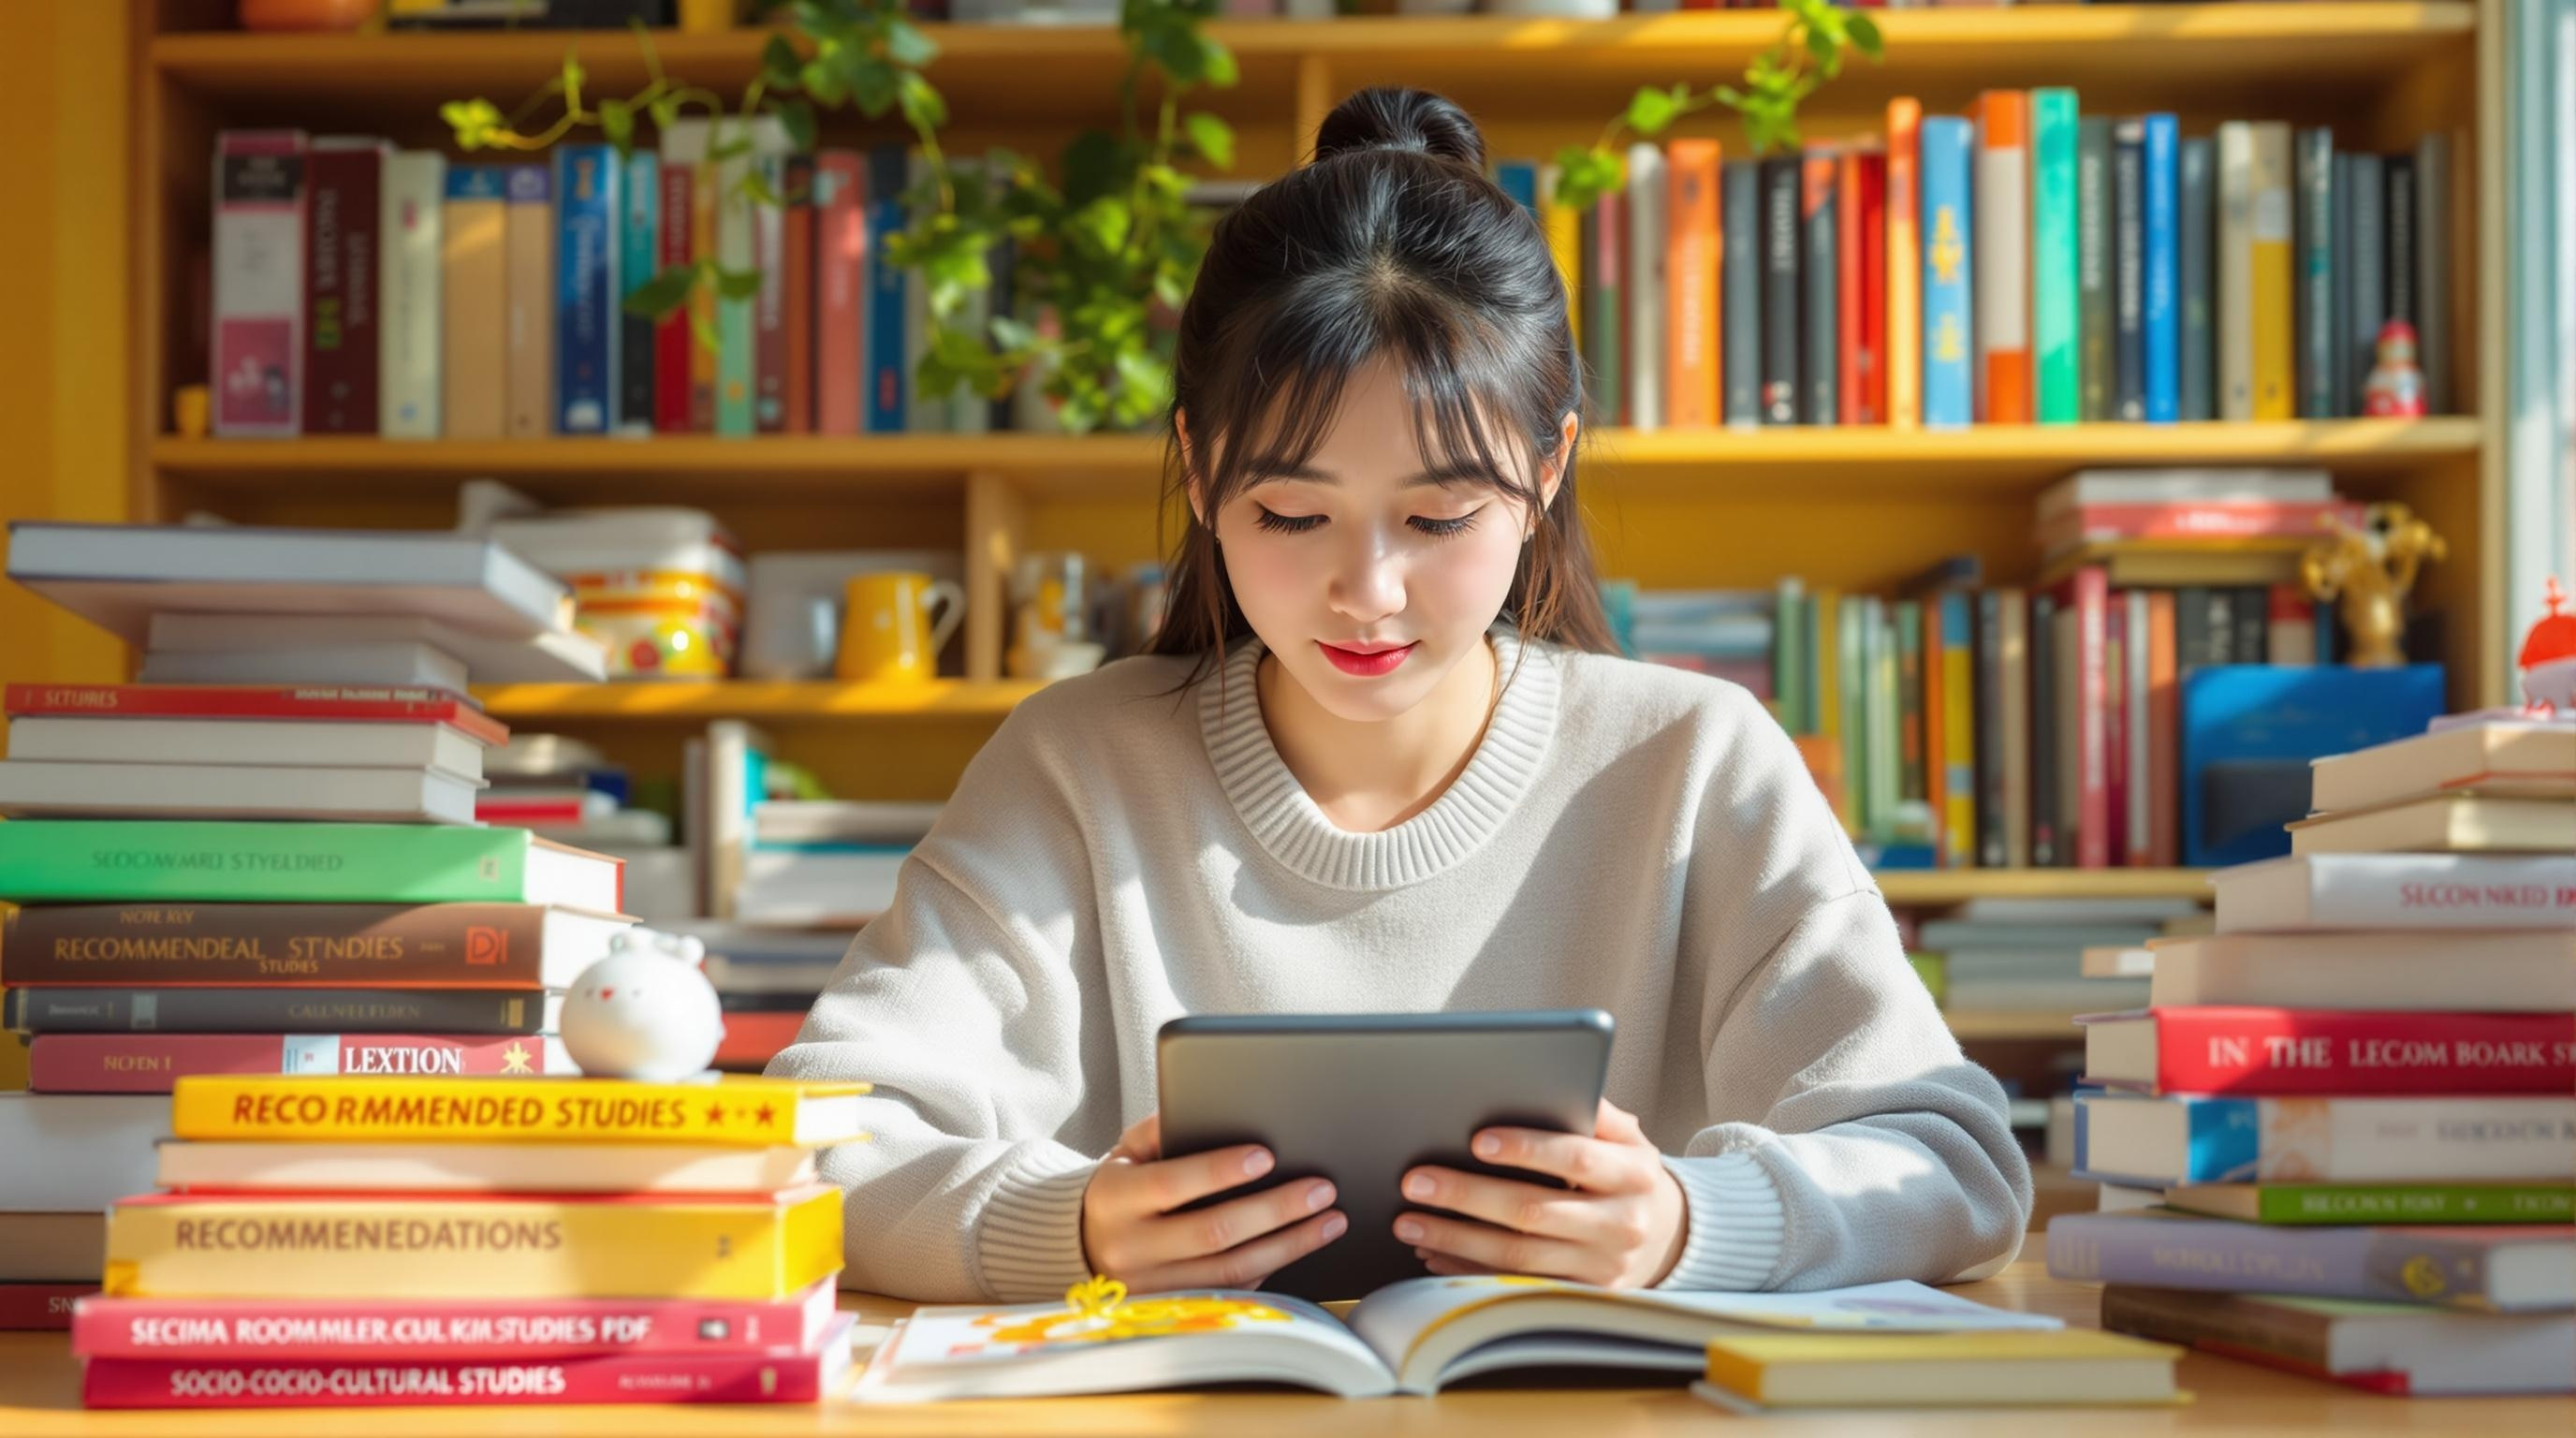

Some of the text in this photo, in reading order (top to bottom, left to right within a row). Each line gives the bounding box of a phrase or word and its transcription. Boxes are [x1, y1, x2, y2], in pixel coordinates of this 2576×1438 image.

[258, 959, 319, 975] STUDIES
[344, 1046, 464, 1075] LEXTION
[2207, 1036, 2248, 1067] IN
[2263, 1036, 2332, 1068] THE
[555, 1097, 688, 1128] STUDIES
[174, 1220, 564, 1252] RECOMMENEDATIONS
[601, 1313, 653, 1343] PDF
[169, 1365, 567, 1397] SOCIO-COCIO-CULTURAL STUDIES
